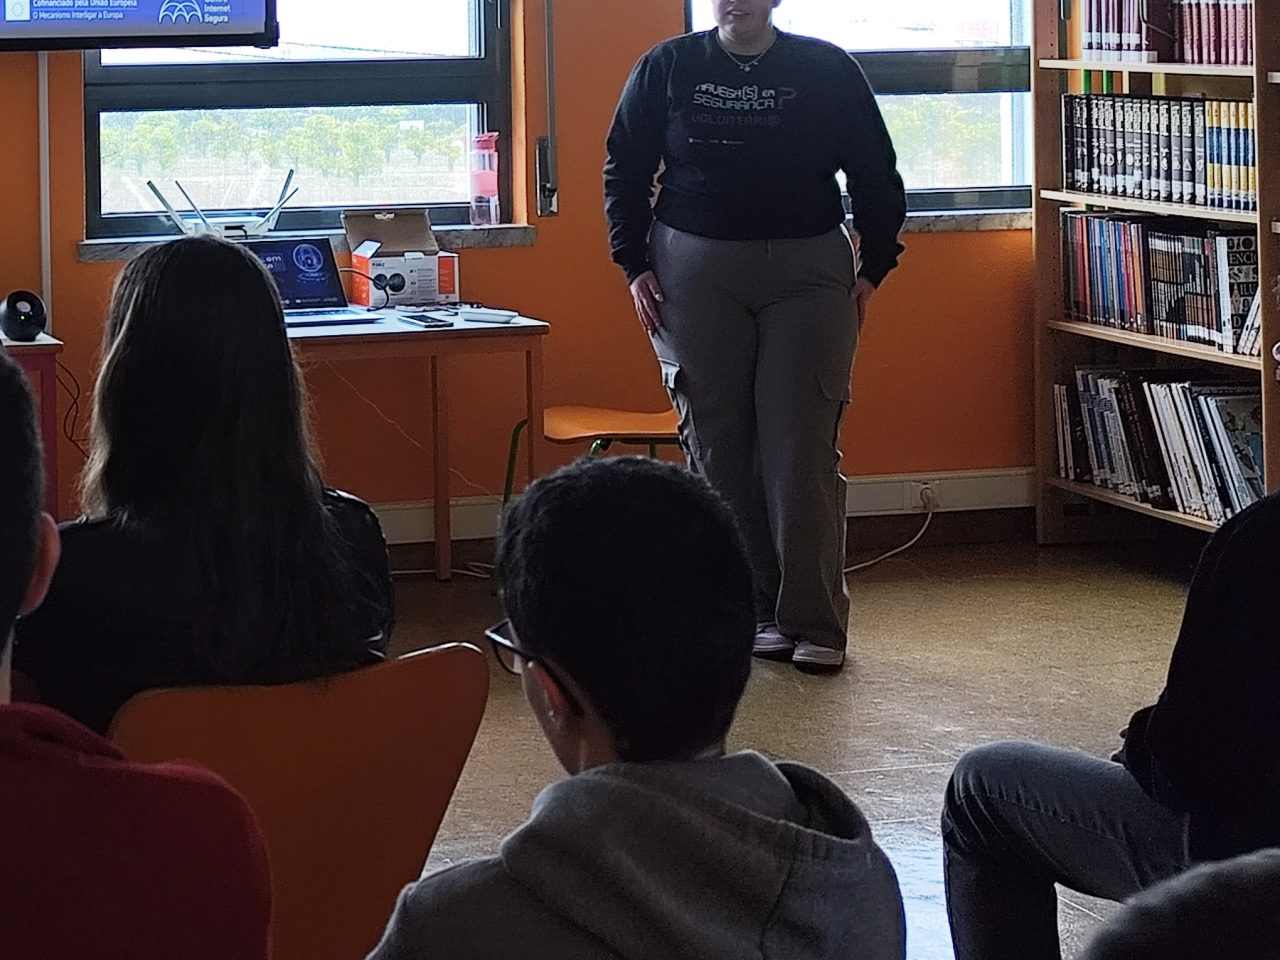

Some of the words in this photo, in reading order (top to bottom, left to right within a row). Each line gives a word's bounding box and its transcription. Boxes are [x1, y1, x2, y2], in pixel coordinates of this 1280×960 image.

[74, 0, 89, 8] pela
[203, 5, 231, 13] Internet
[204, 14, 228, 24] Segura
